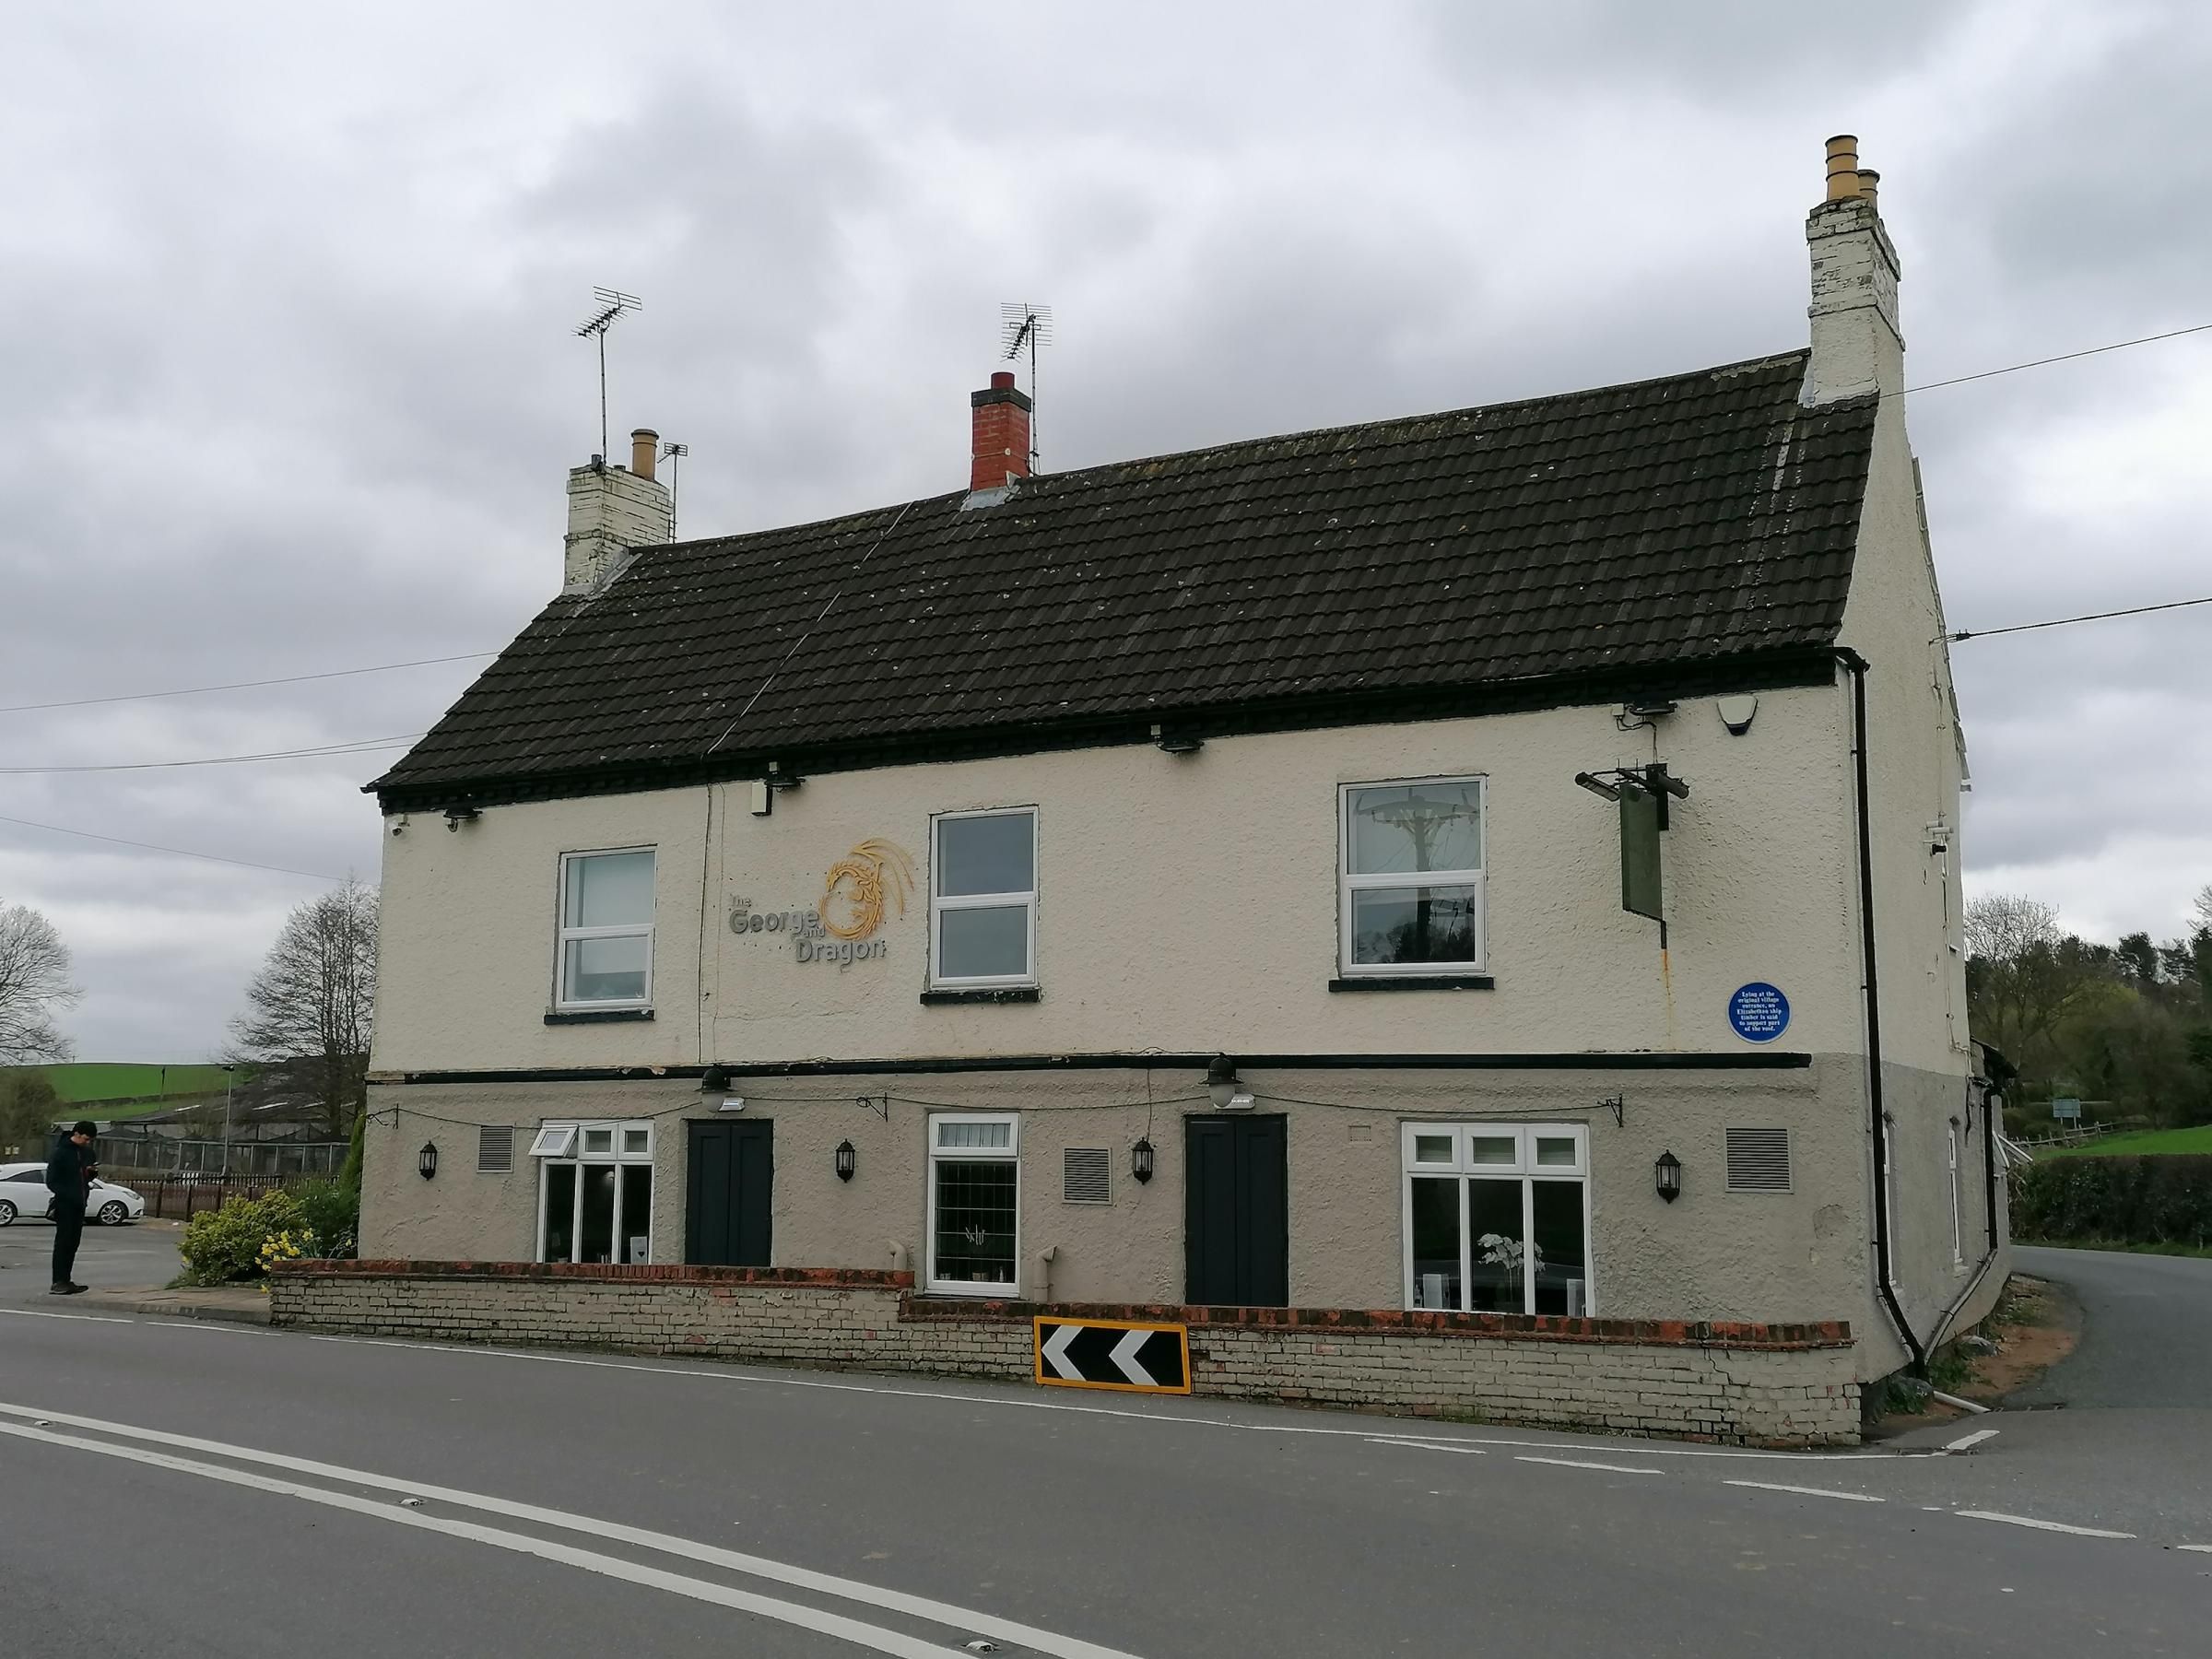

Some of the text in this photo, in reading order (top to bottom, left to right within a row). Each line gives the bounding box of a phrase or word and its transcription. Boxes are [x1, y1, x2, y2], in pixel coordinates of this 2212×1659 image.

[730, 895, 751, 908] The
[729, 909, 819, 938] George
[804, 924, 825, 937] and
[795, 938, 886, 972] Dragon
